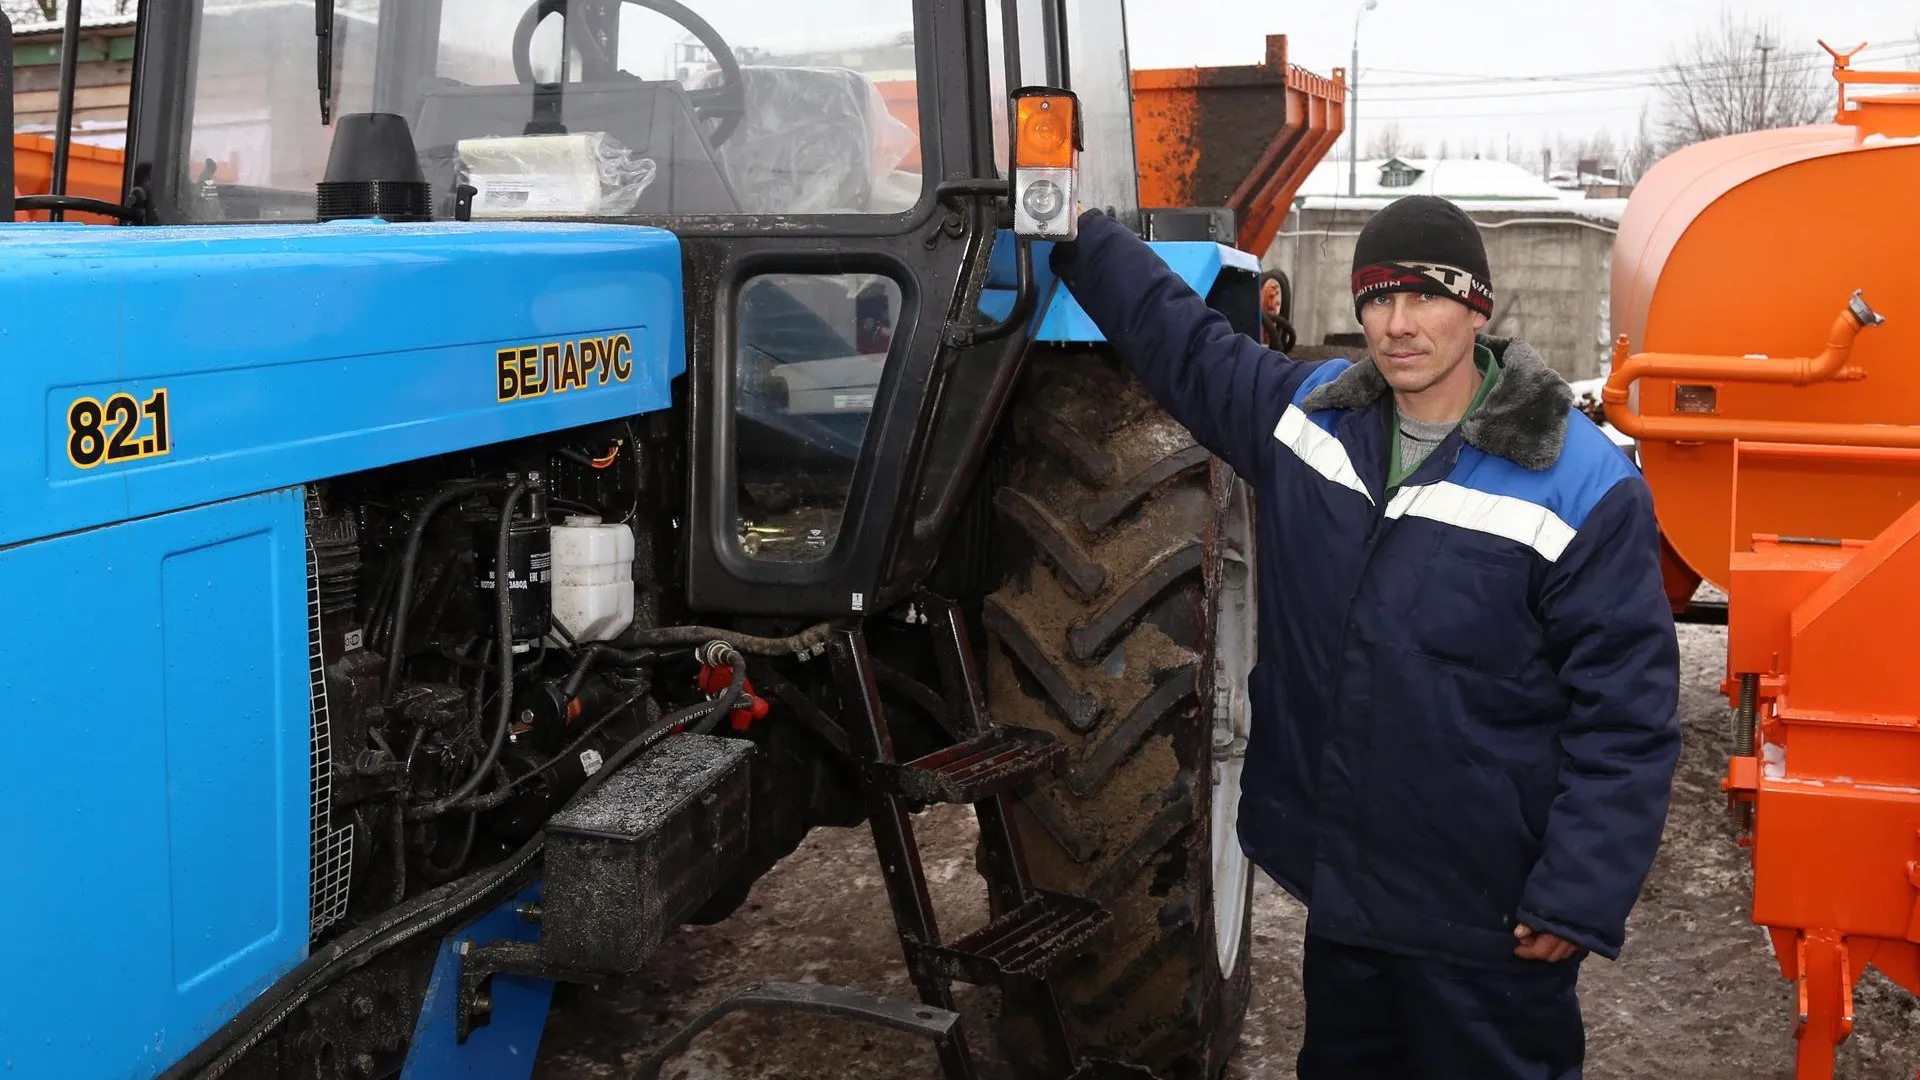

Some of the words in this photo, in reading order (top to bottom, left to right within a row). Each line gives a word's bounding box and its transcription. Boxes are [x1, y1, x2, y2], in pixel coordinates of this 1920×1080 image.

[496, 333, 632, 402] БЕЛАРУС
[67, 388, 170, 469] 82.1
[509, 580, 528, 590] ЗАВОД
